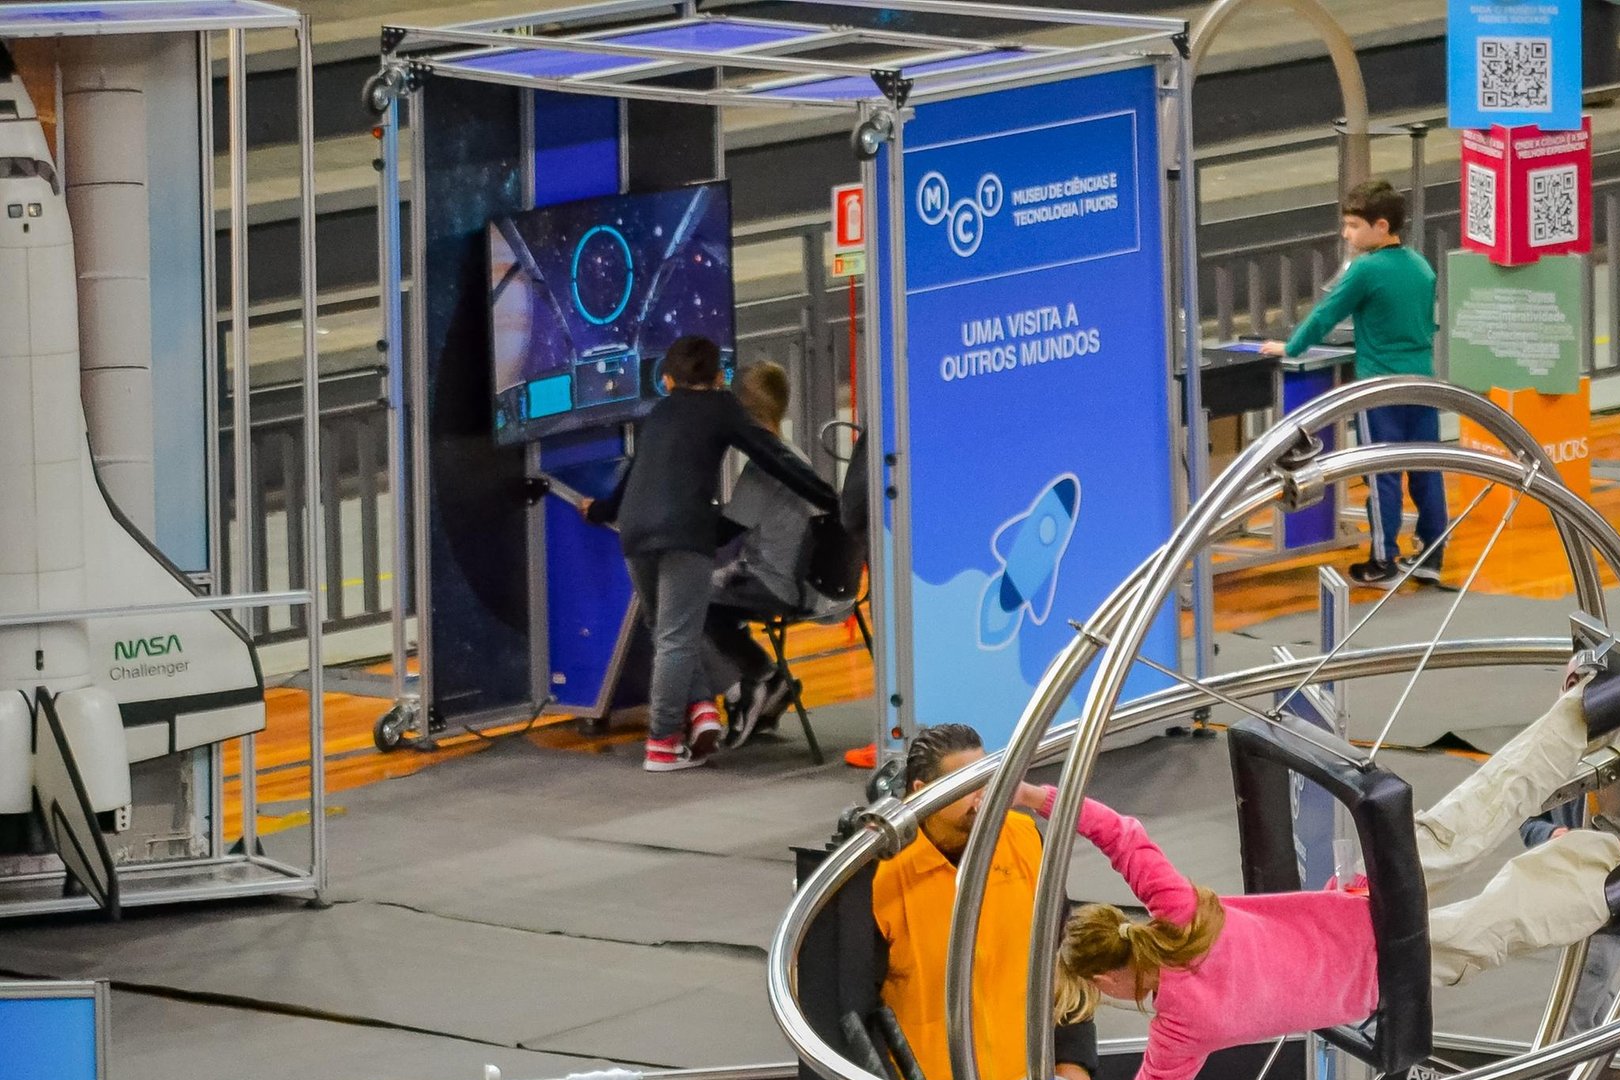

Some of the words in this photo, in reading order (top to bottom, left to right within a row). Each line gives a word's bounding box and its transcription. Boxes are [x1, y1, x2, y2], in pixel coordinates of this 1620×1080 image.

[1013, 187, 1047, 205] MUSEU
[1049, 183, 1063, 198] DE
[1064, 175, 1109, 196] CIÊNCIAS
[1110, 172, 1117, 188] E
[925, 186, 941, 211] M
[958, 211, 974, 243] C
[985, 186, 996, 207] T
[1013, 201, 1078, 226] TECNOLOGIA
[1086, 194, 1118, 213] PUCRS
[962, 317, 1004, 347] UMA
[1007, 306, 1062, 338] VISITA
[1066, 302, 1079, 327] A
[941, 345, 1017, 381] OUTROS
[1021, 328, 1100, 366] MUNDOS
[115, 635, 182, 660] NASA
[110, 662, 190, 681] Challenger
